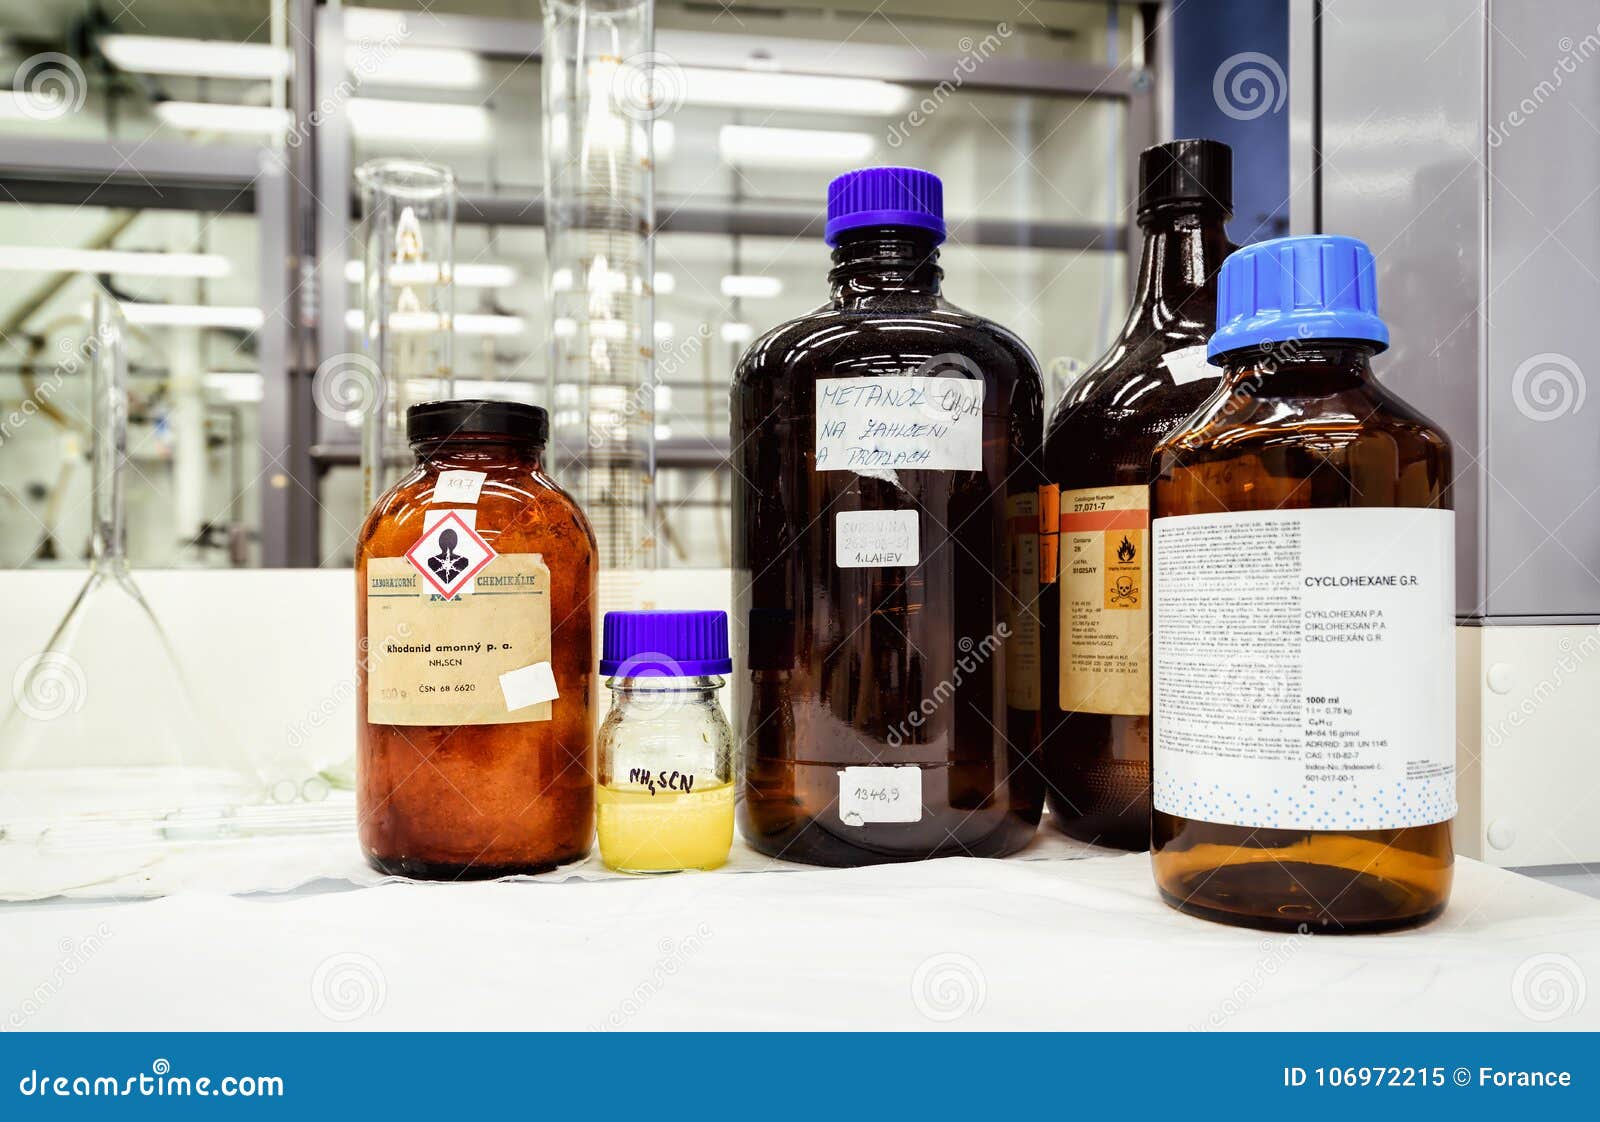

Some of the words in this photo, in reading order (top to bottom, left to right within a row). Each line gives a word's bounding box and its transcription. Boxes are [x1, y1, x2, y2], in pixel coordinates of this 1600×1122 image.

[820, 385, 927, 407] METANOL
[820, 420, 846, 440] NA
[1074, 502, 1106, 512] 27,071-7
[477, 574, 535, 586] CHEMIKÁLIE
[1305, 576, 1397, 587] CYCLOHEXANE
[1400, 576, 1419, 586] G.R.
[1305, 610, 1368, 619] CYKLOHEXAN
[1305, 622, 1371, 631] CIKLOHEKSAN
[387, 644, 431, 653] Rhodanid
[436, 642, 481, 653] amonný
[487, 644, 497, 653] p.
[502, 643, 513, 651] a.
[419, 683, 436, 693] ČSN
[454, 684, 476, 692] 6620
